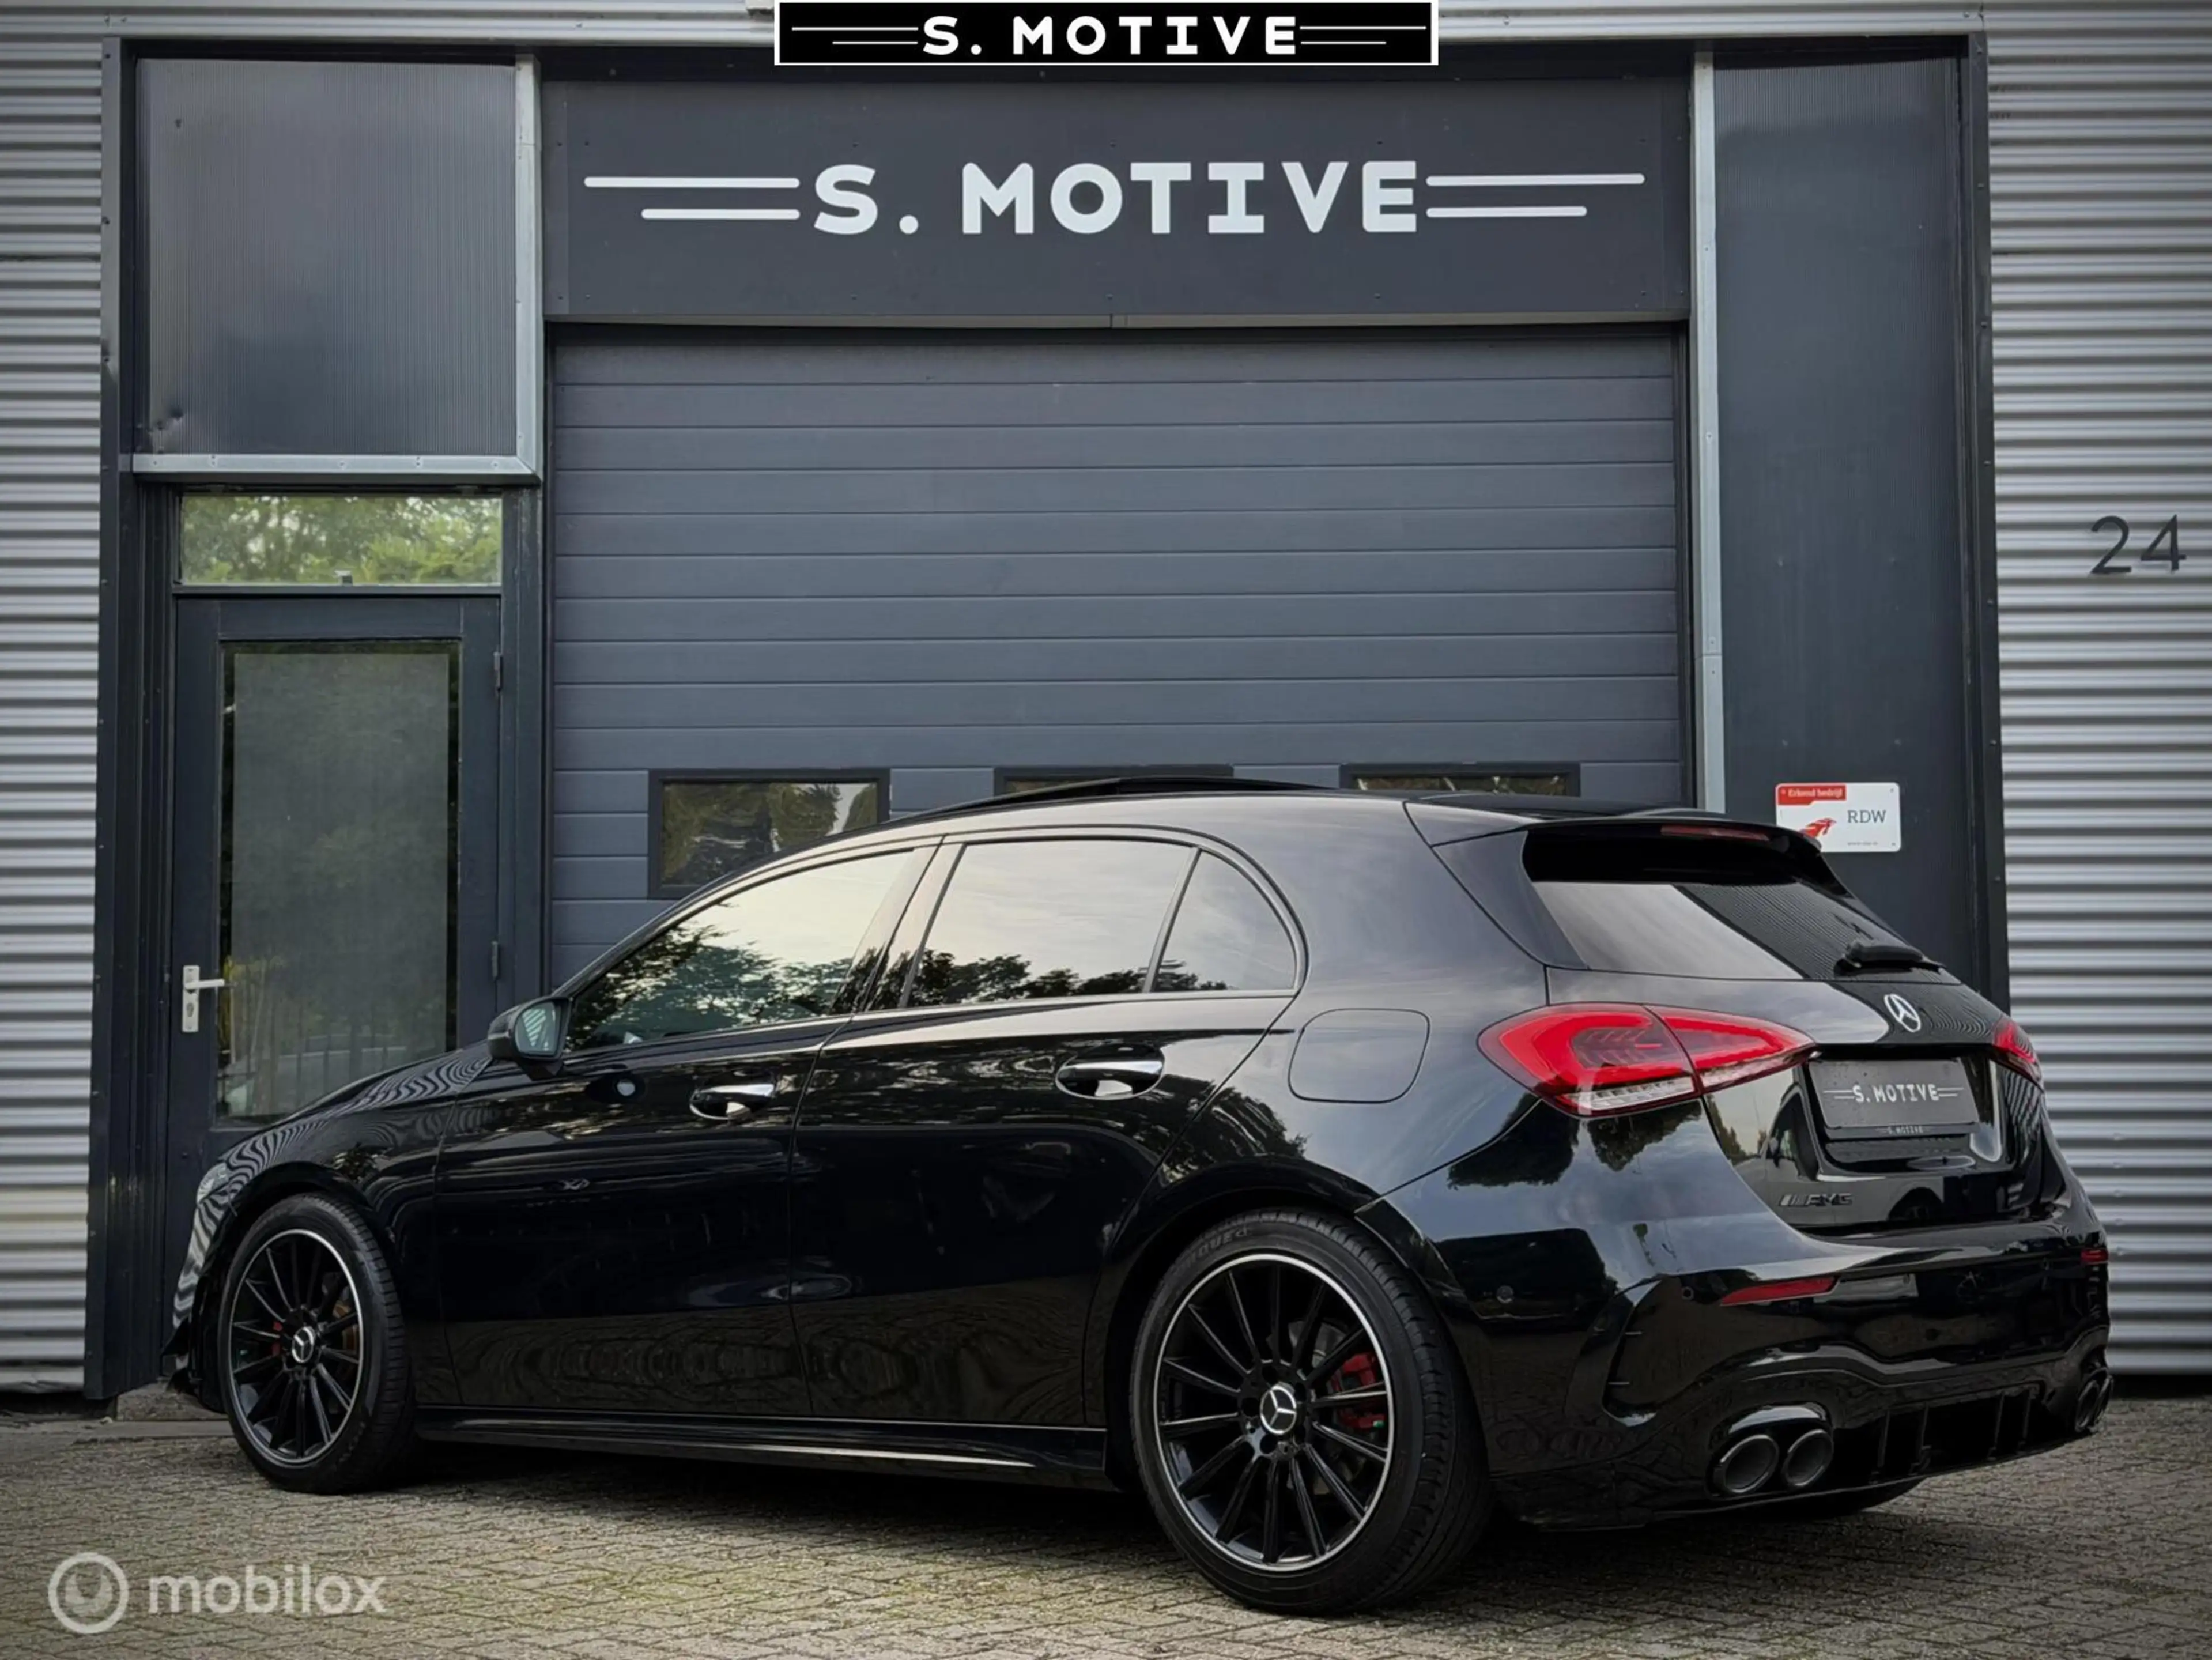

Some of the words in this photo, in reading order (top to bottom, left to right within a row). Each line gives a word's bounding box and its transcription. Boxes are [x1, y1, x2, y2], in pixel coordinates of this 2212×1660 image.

[813, 164, 919, 235] S.
[962, 160, 1417, 235] MOTIVE
[2090, 514, 2187, 574] 24
[1847, 809, 1886, 824] RDW
[1852, 1085, 1871, 1103] S.
[1872, 1083, 1939, 1103] MOTIVE
